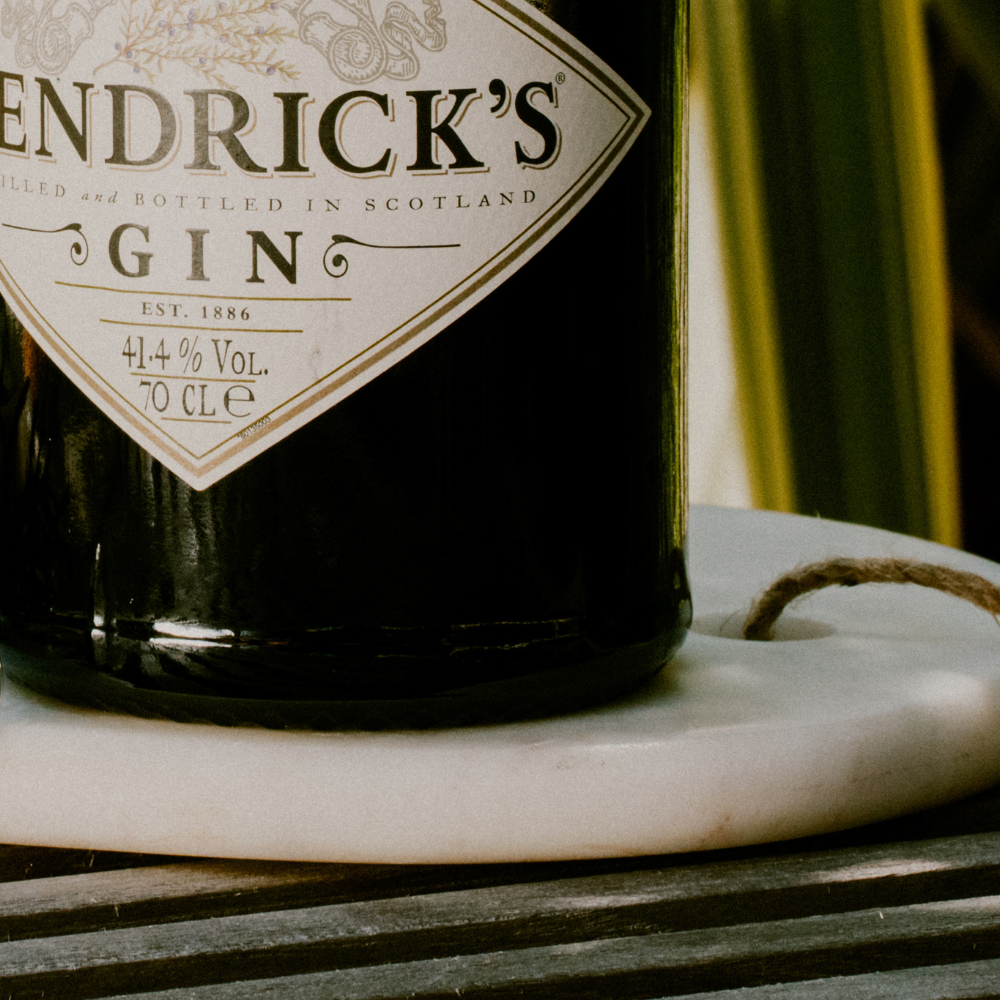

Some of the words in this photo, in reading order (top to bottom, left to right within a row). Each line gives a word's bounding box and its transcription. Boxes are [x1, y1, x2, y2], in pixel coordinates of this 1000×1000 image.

[81, 190, 119, 204] and
[135, 192, 283, 211] BOTTLED
[306, 198, 341, 212] IN
[365, 189, 536, 211] SCOTLAND
[108, 223, 303, 284] GIN
[141, 301, 188, 318] EST.
[200, 305, 250, 321] 1886
[139, 379, 169, 413] 70
